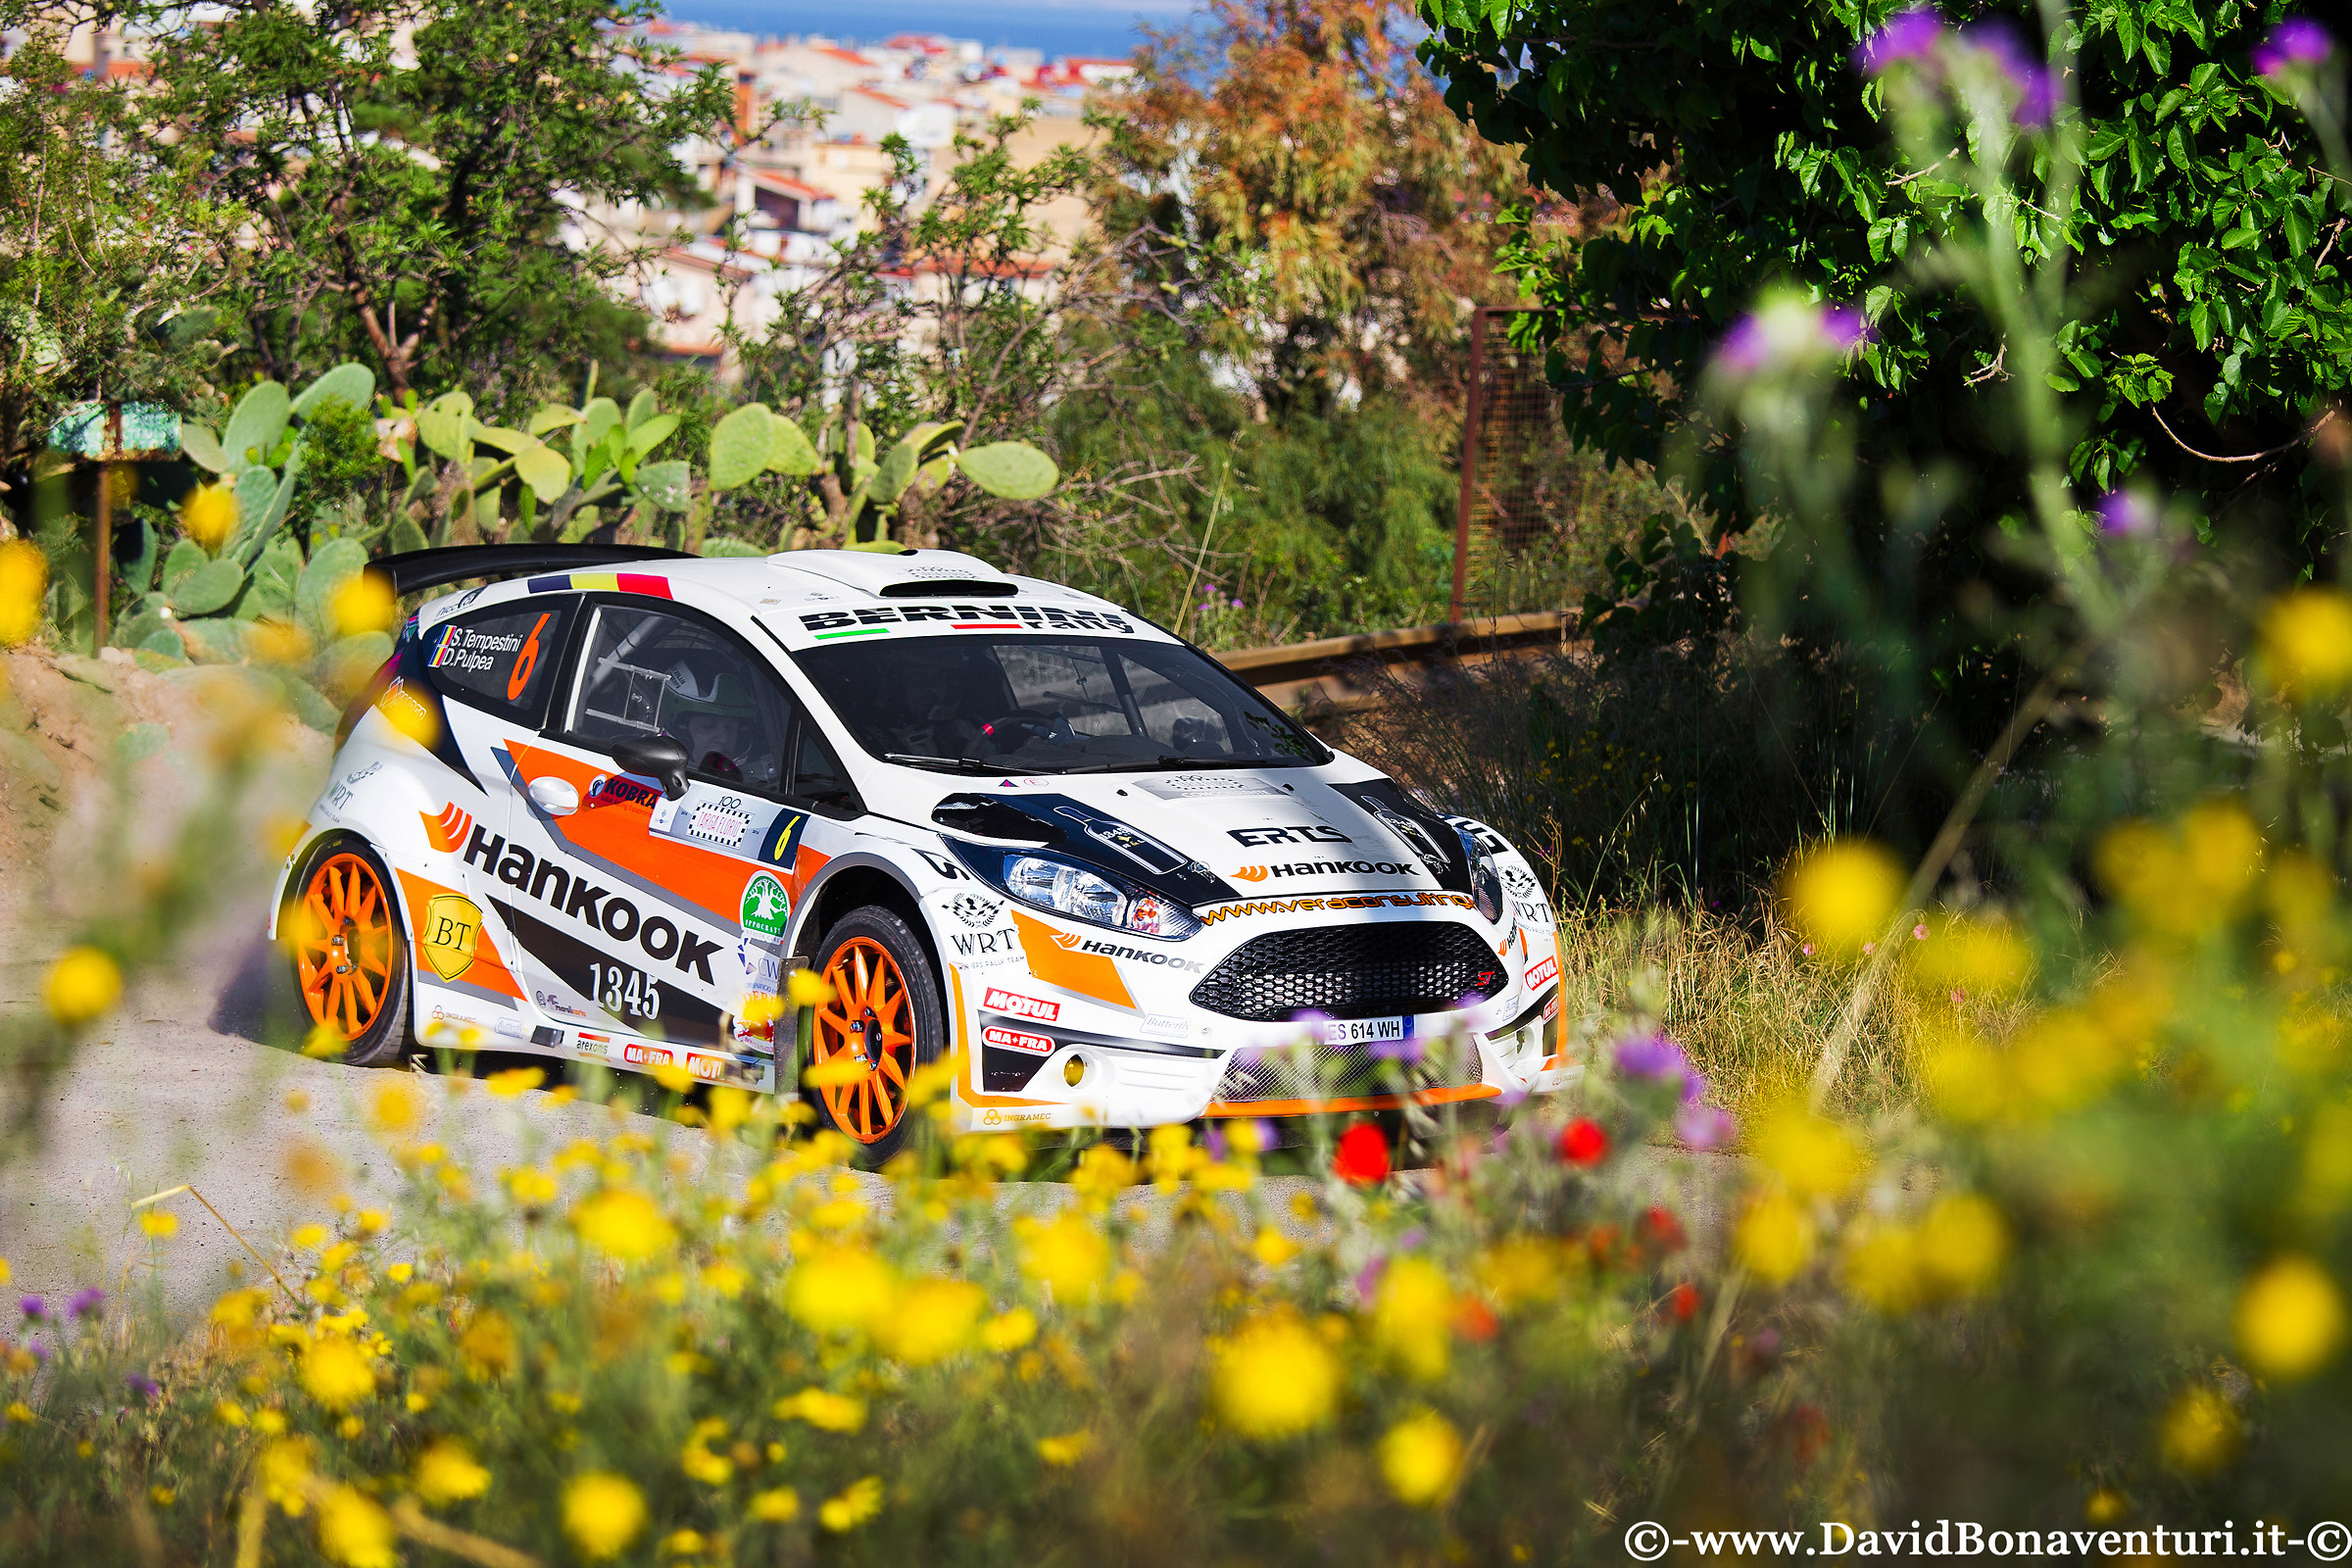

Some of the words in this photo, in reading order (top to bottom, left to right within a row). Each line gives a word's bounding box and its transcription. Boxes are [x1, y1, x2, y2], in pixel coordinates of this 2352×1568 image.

[507, 612, 551, 701] 6
[604, 778, 661, 809] KOBRA
[717, 796, 742, 809] 100
[774, 815, 801, 861] 6
[1226, 825, 1353, 848] ERTS
[432, 916, 471, 951] BT
[951, 928, 1015, 956] WRT
[1526, 958, 1558, 990] MOTUL
[590, 962, 661, 1020] 1345
[986, 989, 1058, 1019] MOTUL
[1327, 1024, 1347, 1041] ES
[1350, 1022, 1374, 1039] 614
[1377, 1018, 1400, 1038] WH
[1004, 1112, 1052, 1122] INGRAMEC
